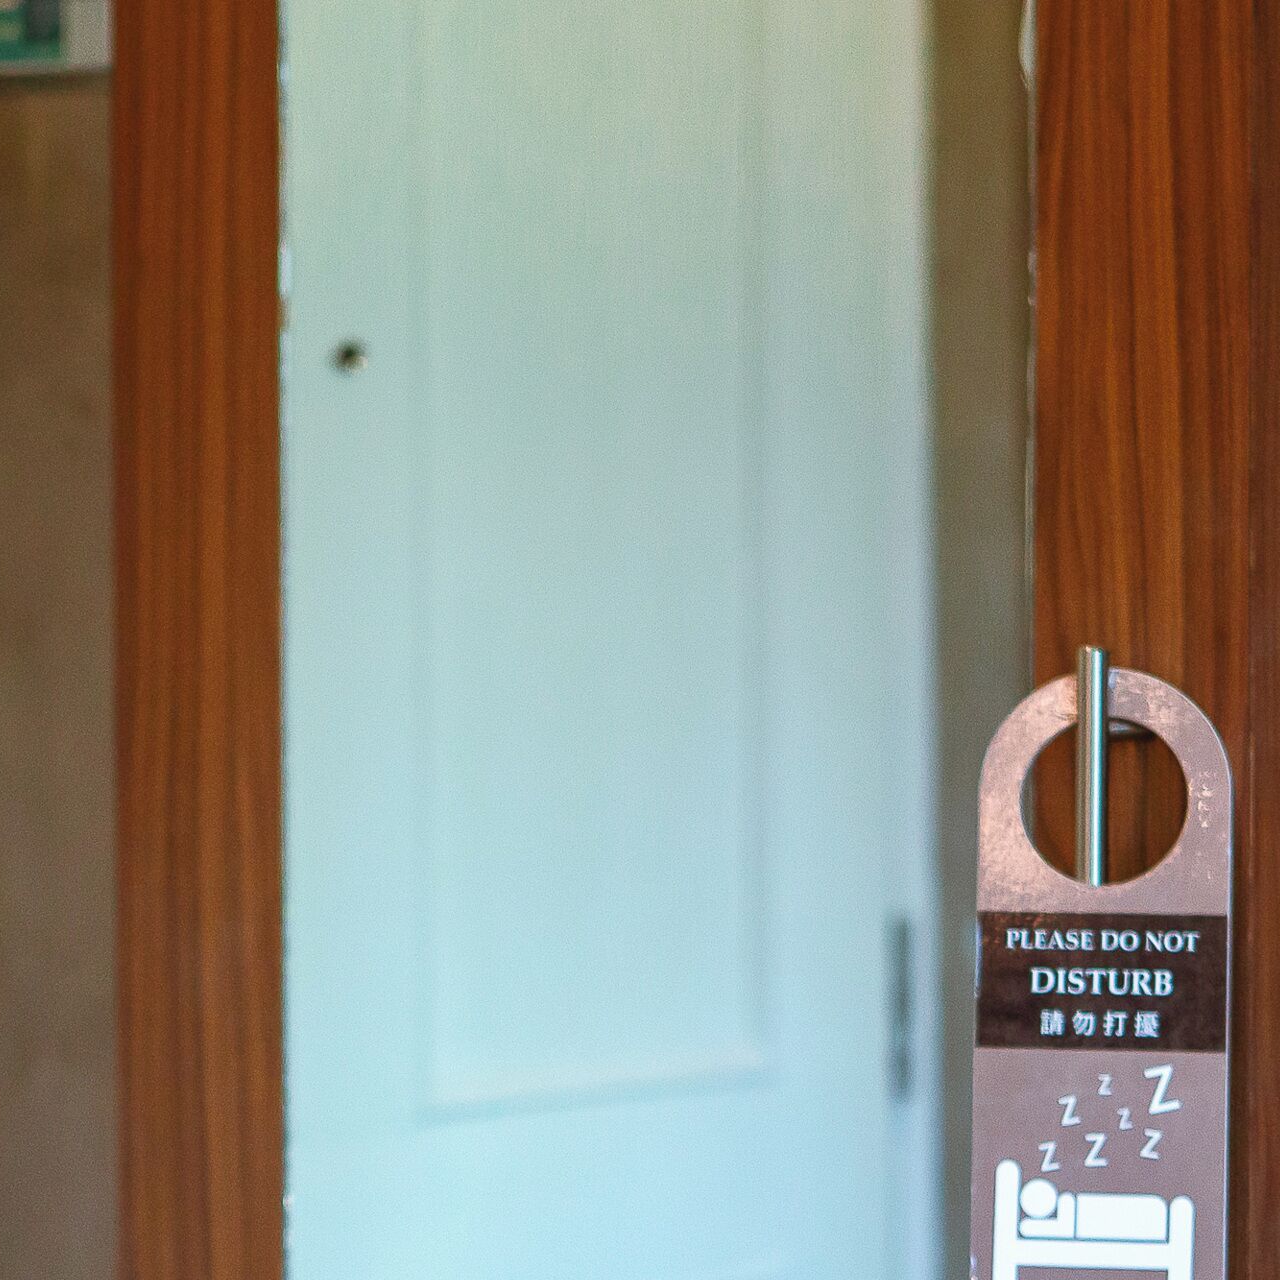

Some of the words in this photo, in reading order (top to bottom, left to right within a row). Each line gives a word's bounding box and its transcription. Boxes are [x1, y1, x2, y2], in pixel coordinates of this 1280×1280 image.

[1005, 928, 1094, 950] PLEASE
[1101, 929, 1141, 951] DO
[1145, 930, 1201, 953] NOT
[1029, 966, 1174, 996] DISTURB
[1039, 1008, 1161, 1038] 請勿打擾
